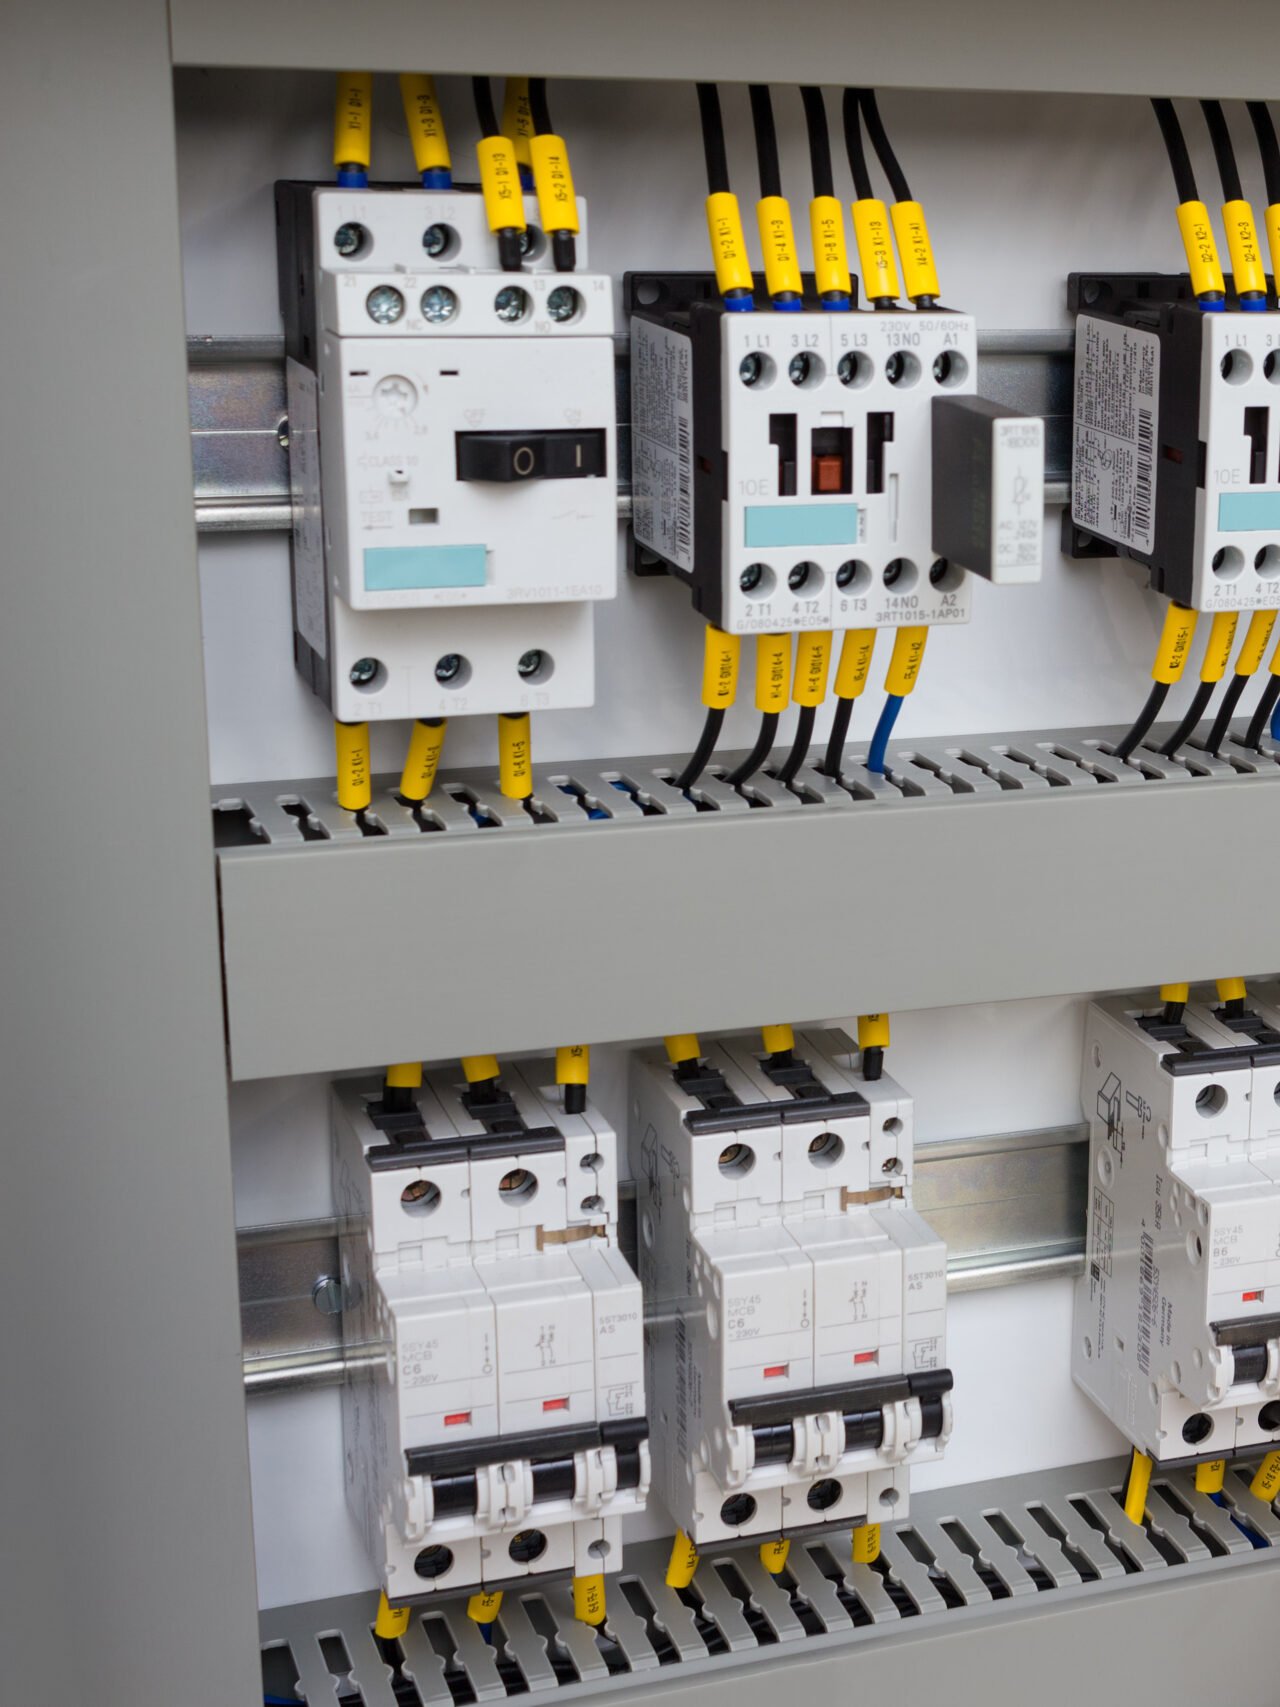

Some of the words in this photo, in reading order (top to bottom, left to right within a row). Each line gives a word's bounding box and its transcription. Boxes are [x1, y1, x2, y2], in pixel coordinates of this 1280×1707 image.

[879, 320, 911, 333] 230V
[743, 334, 751, 348] 1
[757, 334, 770, 348] L1
[791, 333, 800, 348] 3
[804, 333, 819, 348] L2
[840, 332, 848, 347] 5
[853, 332, 869, 347] L3
[943, 331, 959, 347] A1
[1224, 333, 1230, 347] 1
[1235, 333, 1248, 347] L1
[1265, 333, 1273, 347] 3
[1213, 582, 1222, 596] 2
[1225, 582, 1238, 596] T1
[1254, 580, 1263, 594] 4
[1266, 580, 1280, 594] T2
[744, 603, 754, 617] 2
[756, 603, 772, 616] T1
[791, 601, 800, 615] 4
[804, 600, 820, 614] T2
[853, 598, 868, 612] T3
